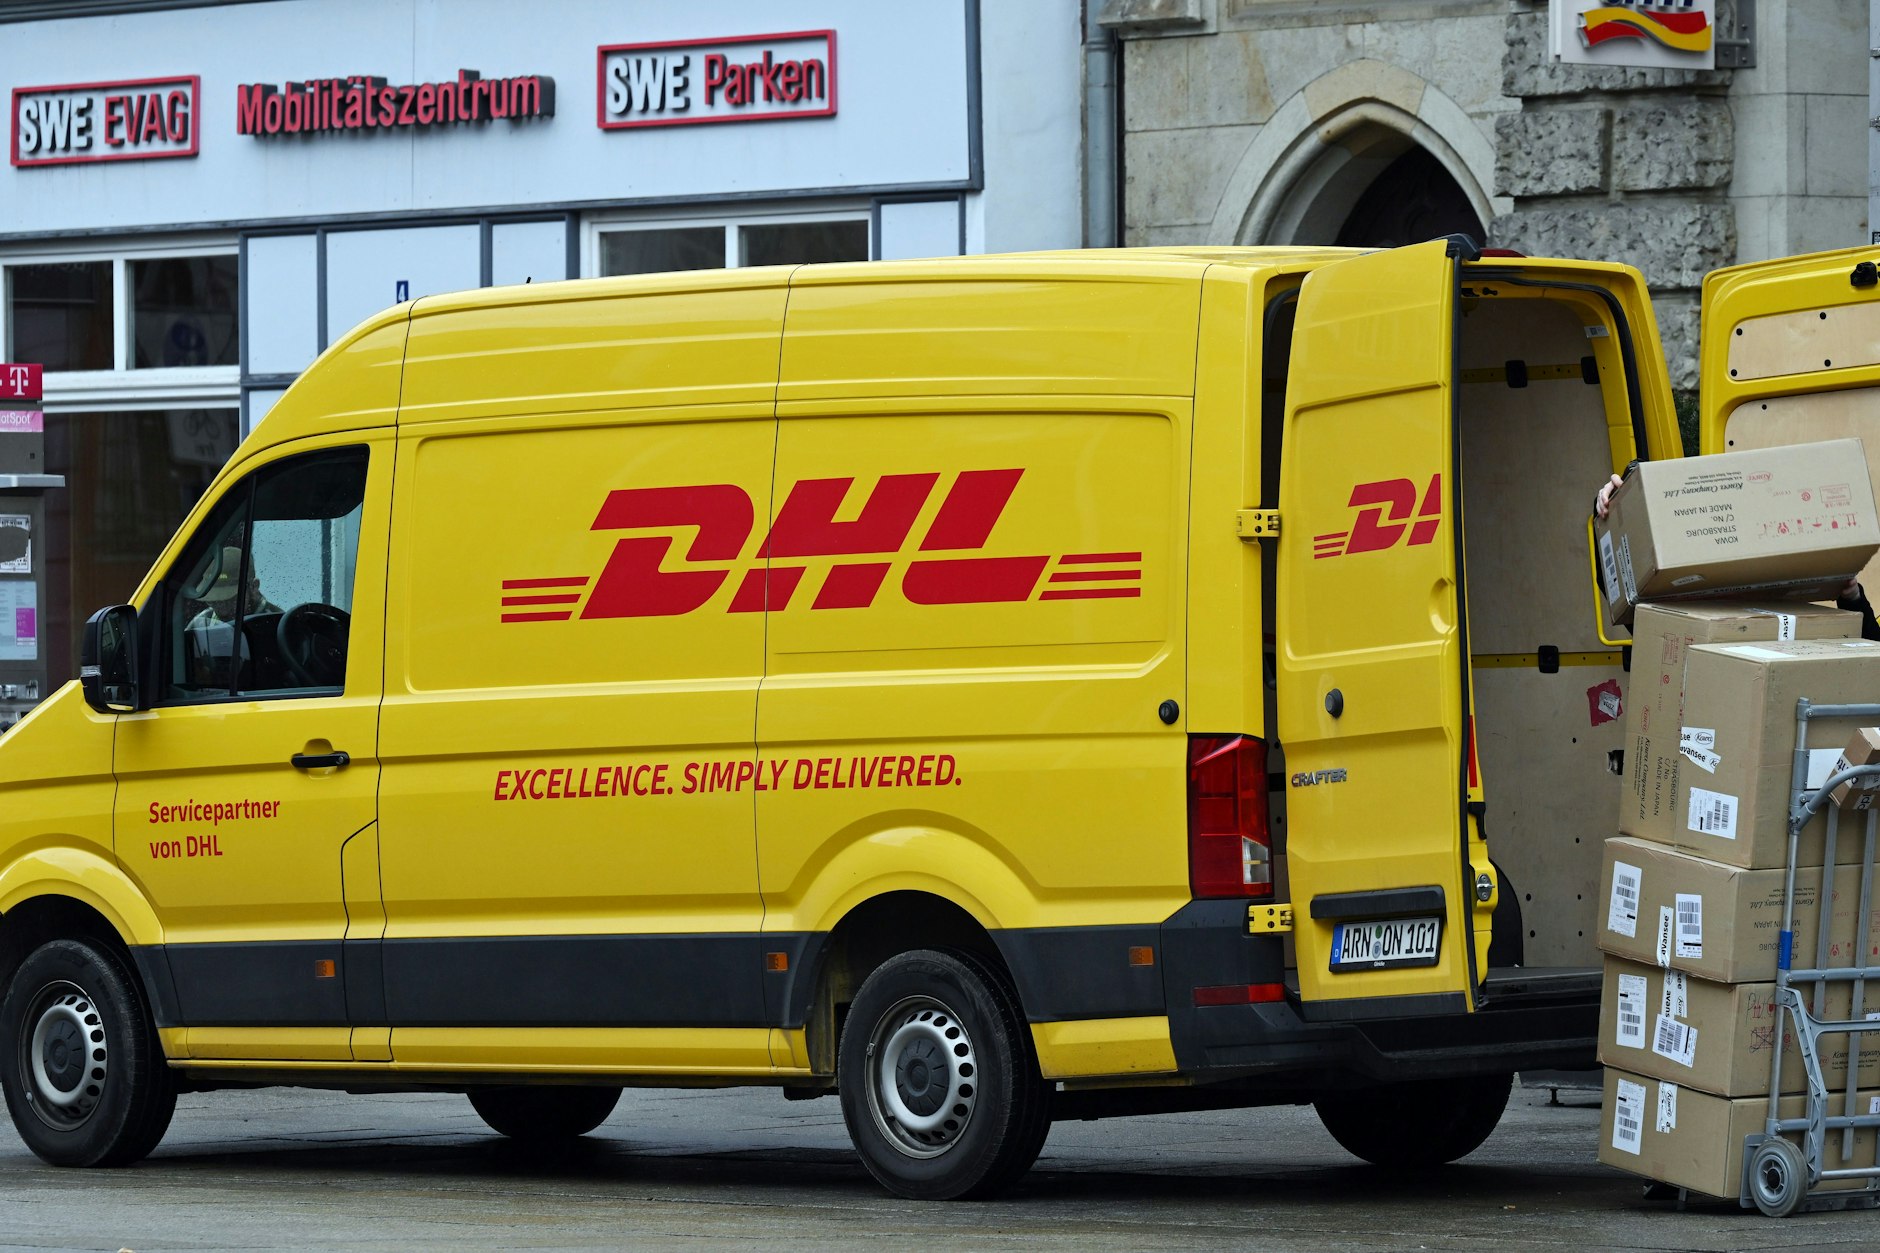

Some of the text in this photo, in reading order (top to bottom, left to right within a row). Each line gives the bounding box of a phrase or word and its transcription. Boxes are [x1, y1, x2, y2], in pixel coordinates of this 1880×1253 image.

[600, 50, 824, 115] SWE Parken
[237, 69, 553, 136] Mobilitätszentrum
[19, 91, 189, 152] SWE EVAG
[0, 412, 30, 426] otSpot
[1720, 482, 1743, 490] Kowa
[1674, 507, 1698, 516] JAPAN
[1710, 504, 1732, 513] MADE
[1686, 525, 1737, 537] STRASBOURG
[1715, 535, 1739, 545] KOWA
[579, 468, 1050, 620] DHL
[494, 754, 961, 801] EXCELLENCE. SIMPLY DELIVERED.
[1291, 768, 1347, 787] CRAFTER
[1655, 781, 1662, 791] IN
[1669, 760, 1678, 812] STRASBOURG
[149, 799, 280, 826] Servicepartner
[1653, 792, 1661, 816] JAPAN
[149, 835, 223, 859] von DHL
[1334, 922, 1436, 959] D ARN ON 101
[1662, 915, 1670, 956] avansee
